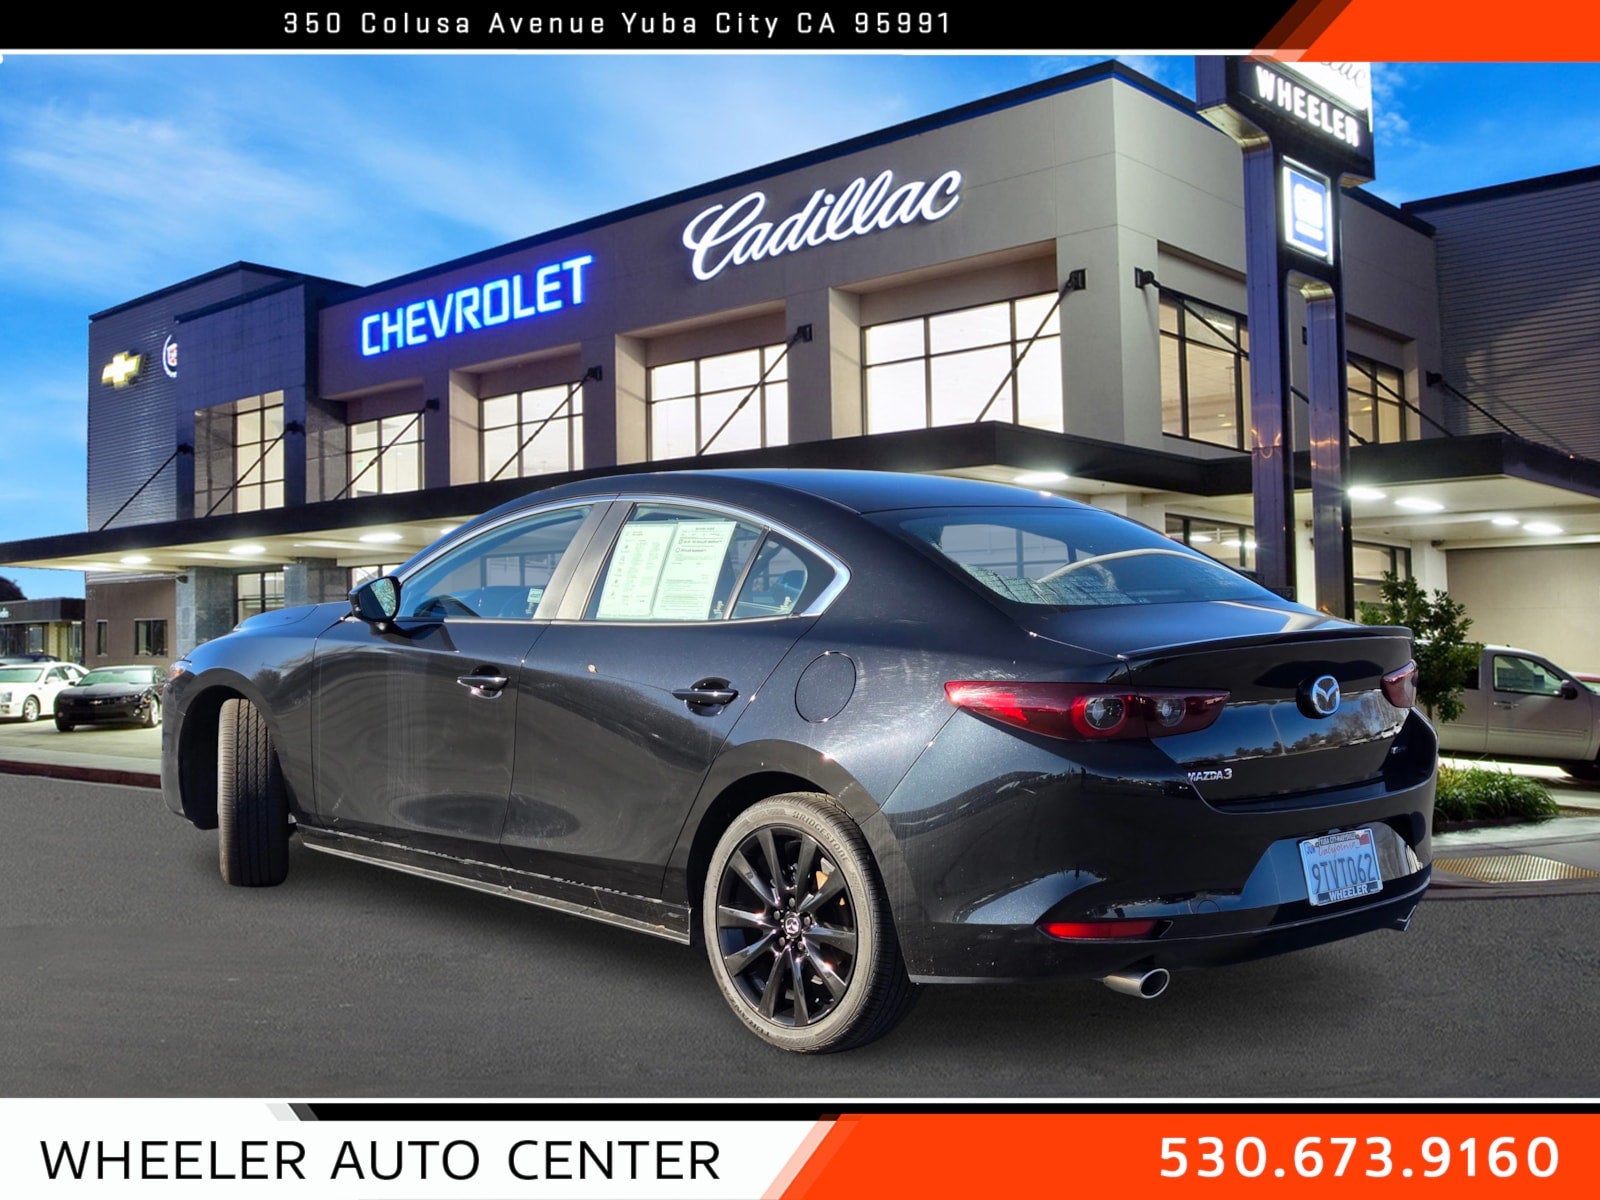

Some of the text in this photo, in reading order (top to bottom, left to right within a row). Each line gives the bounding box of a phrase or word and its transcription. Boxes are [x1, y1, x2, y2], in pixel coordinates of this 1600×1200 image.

[1255, 65, 1360, 148] WHEELER
[682, 169, 962, 281] Cadillac
[361, 254, 594, 357] CHEVROLET
[1187, 767, 1233, 782] MAZDA3
[1311, 853, 1376, 895] 9TVT062
[1328, 884, 1368, 901] WHEELER
